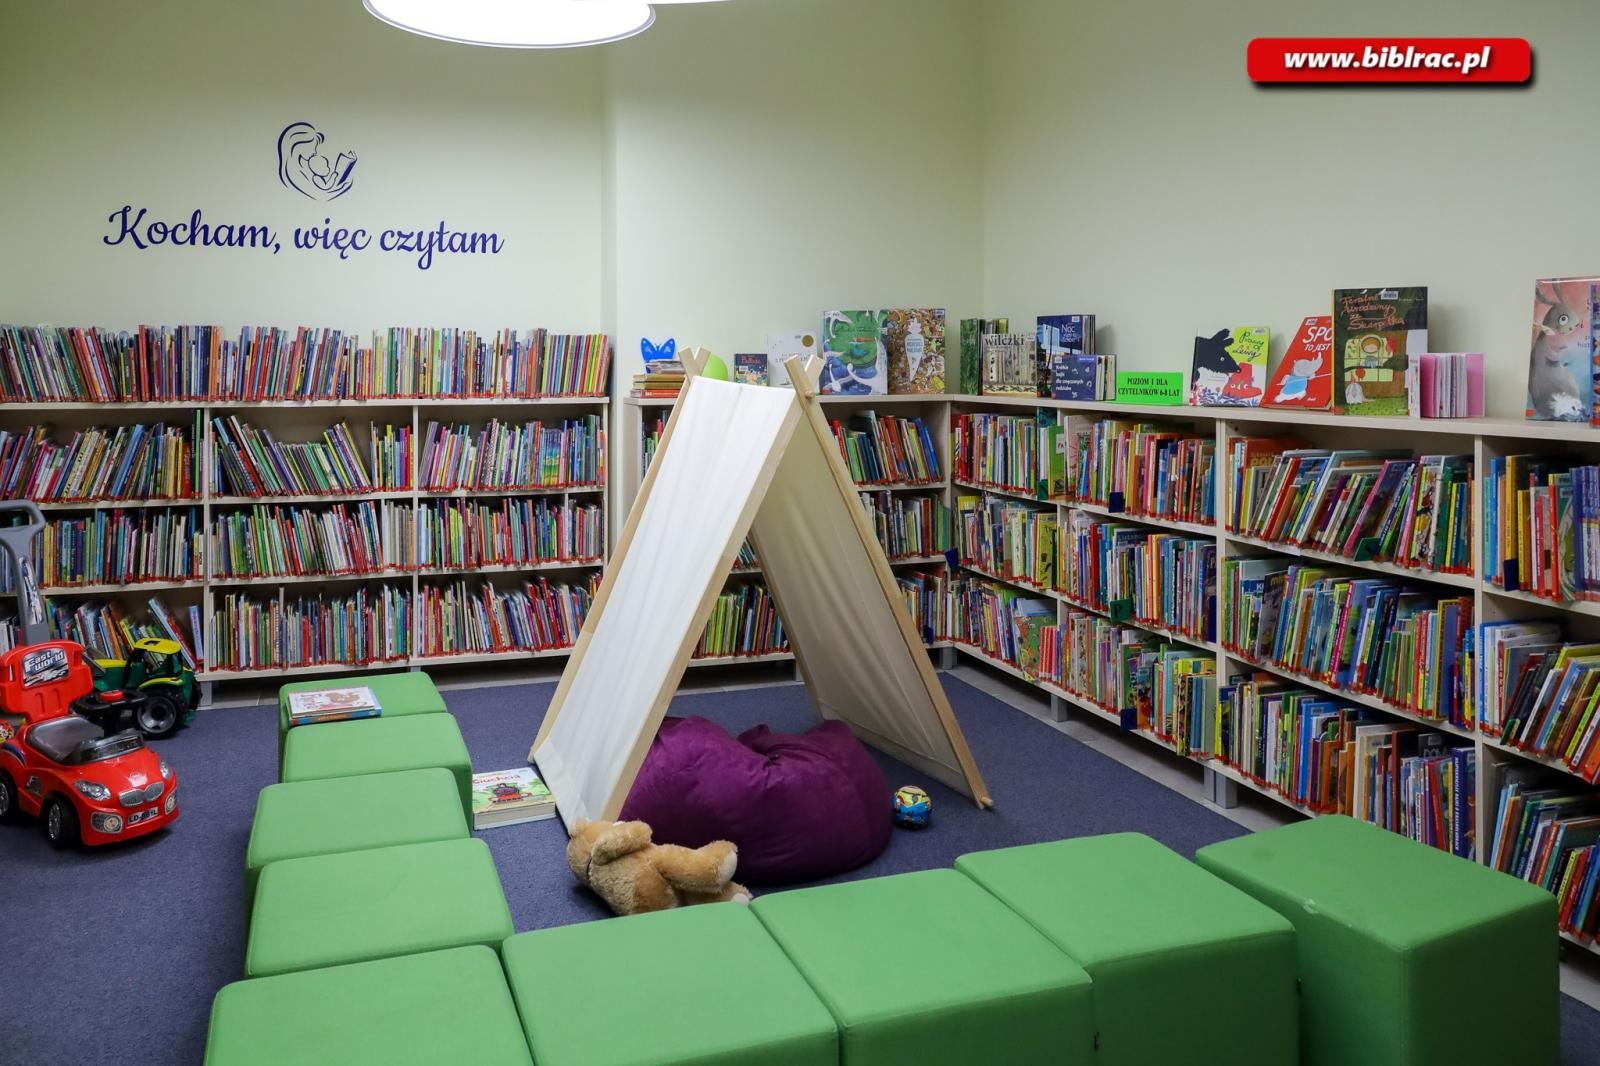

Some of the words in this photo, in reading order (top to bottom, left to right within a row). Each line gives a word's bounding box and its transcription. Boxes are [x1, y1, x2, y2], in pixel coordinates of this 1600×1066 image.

[103, 205, 280, 255] Kocham,
[294, 217, 372, 260] więc
[379, 221, 505, 270] czytam
[1304, 343, 1314, 351] TO
[1312, 343, 1331, 352] JEST
[1127, 377, 1149, 385] POZIOM
[1156, 378, 1168, 386] DLA
[1168, 389, 1180, 397] LAT
